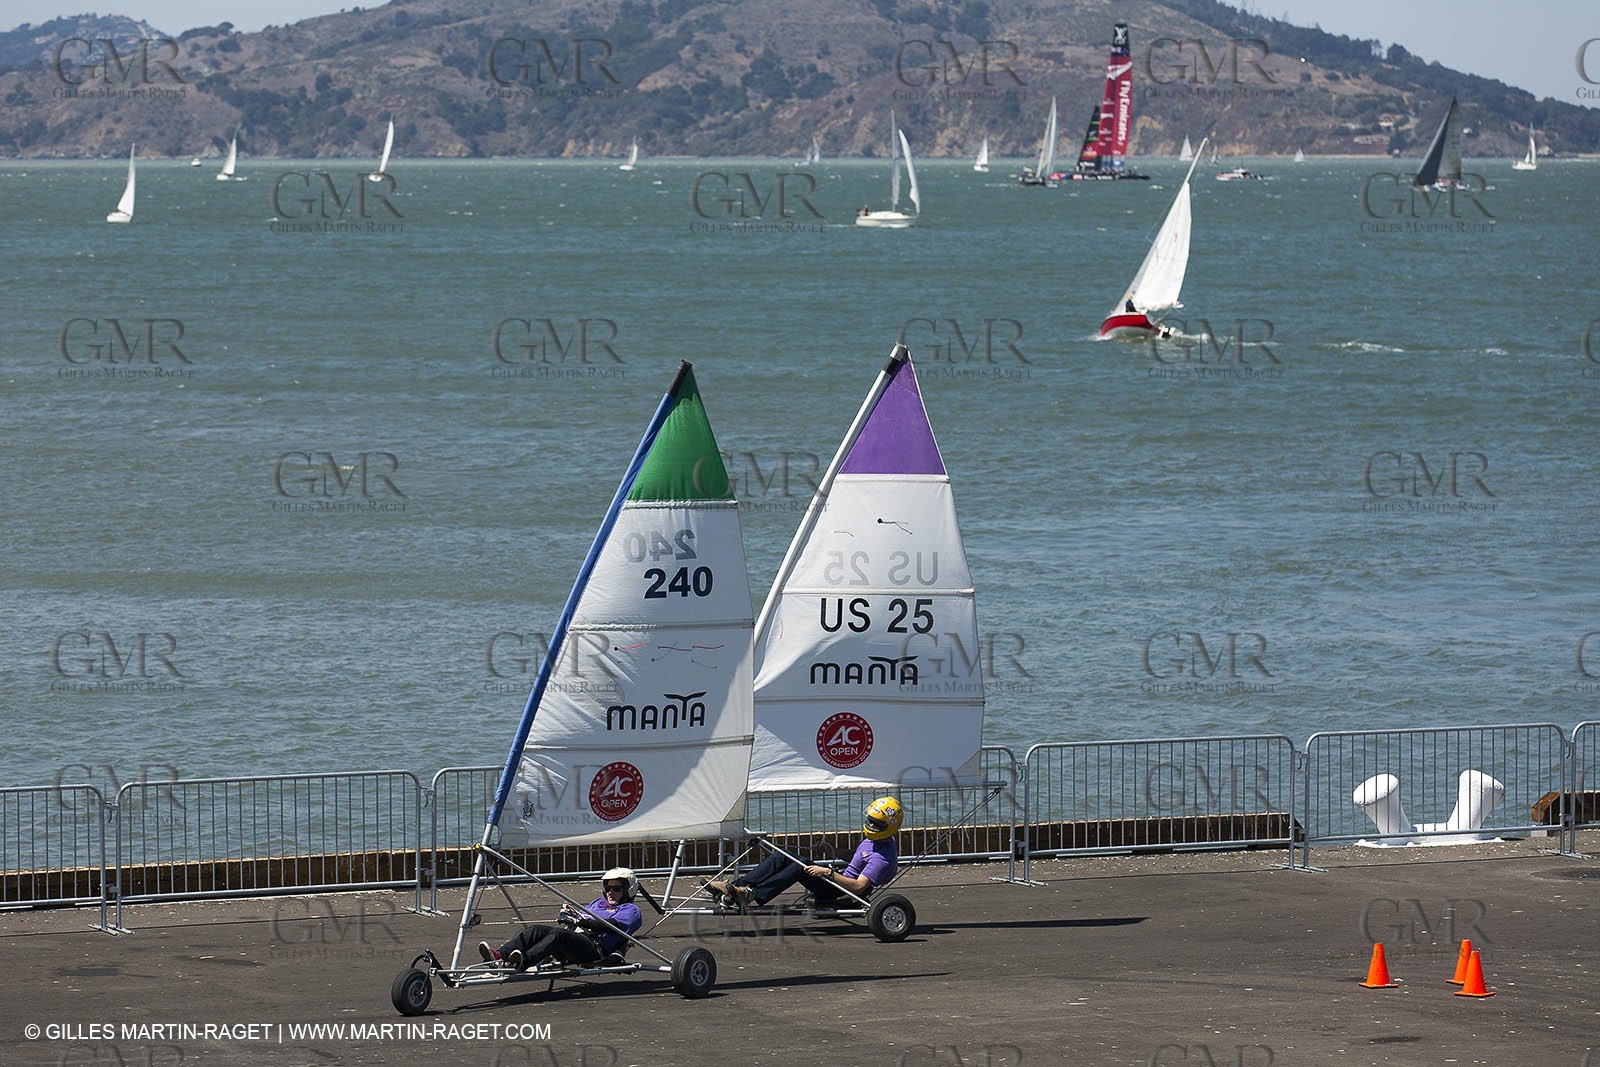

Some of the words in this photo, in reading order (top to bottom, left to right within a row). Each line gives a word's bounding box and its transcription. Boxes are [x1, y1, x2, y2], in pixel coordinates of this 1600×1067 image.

[644, 566, 713, 599] 240
[820, 598, 870, 632] US
[887, 598, 934, 634] 25
[827, 725, 860, 746] AC
[830, 747, 858, 756] OPEN
[830, 760, 860, 768] FRANCISCO
[600, 776, 633, 798] AC
[601, 800, 628, 808] OPEN
